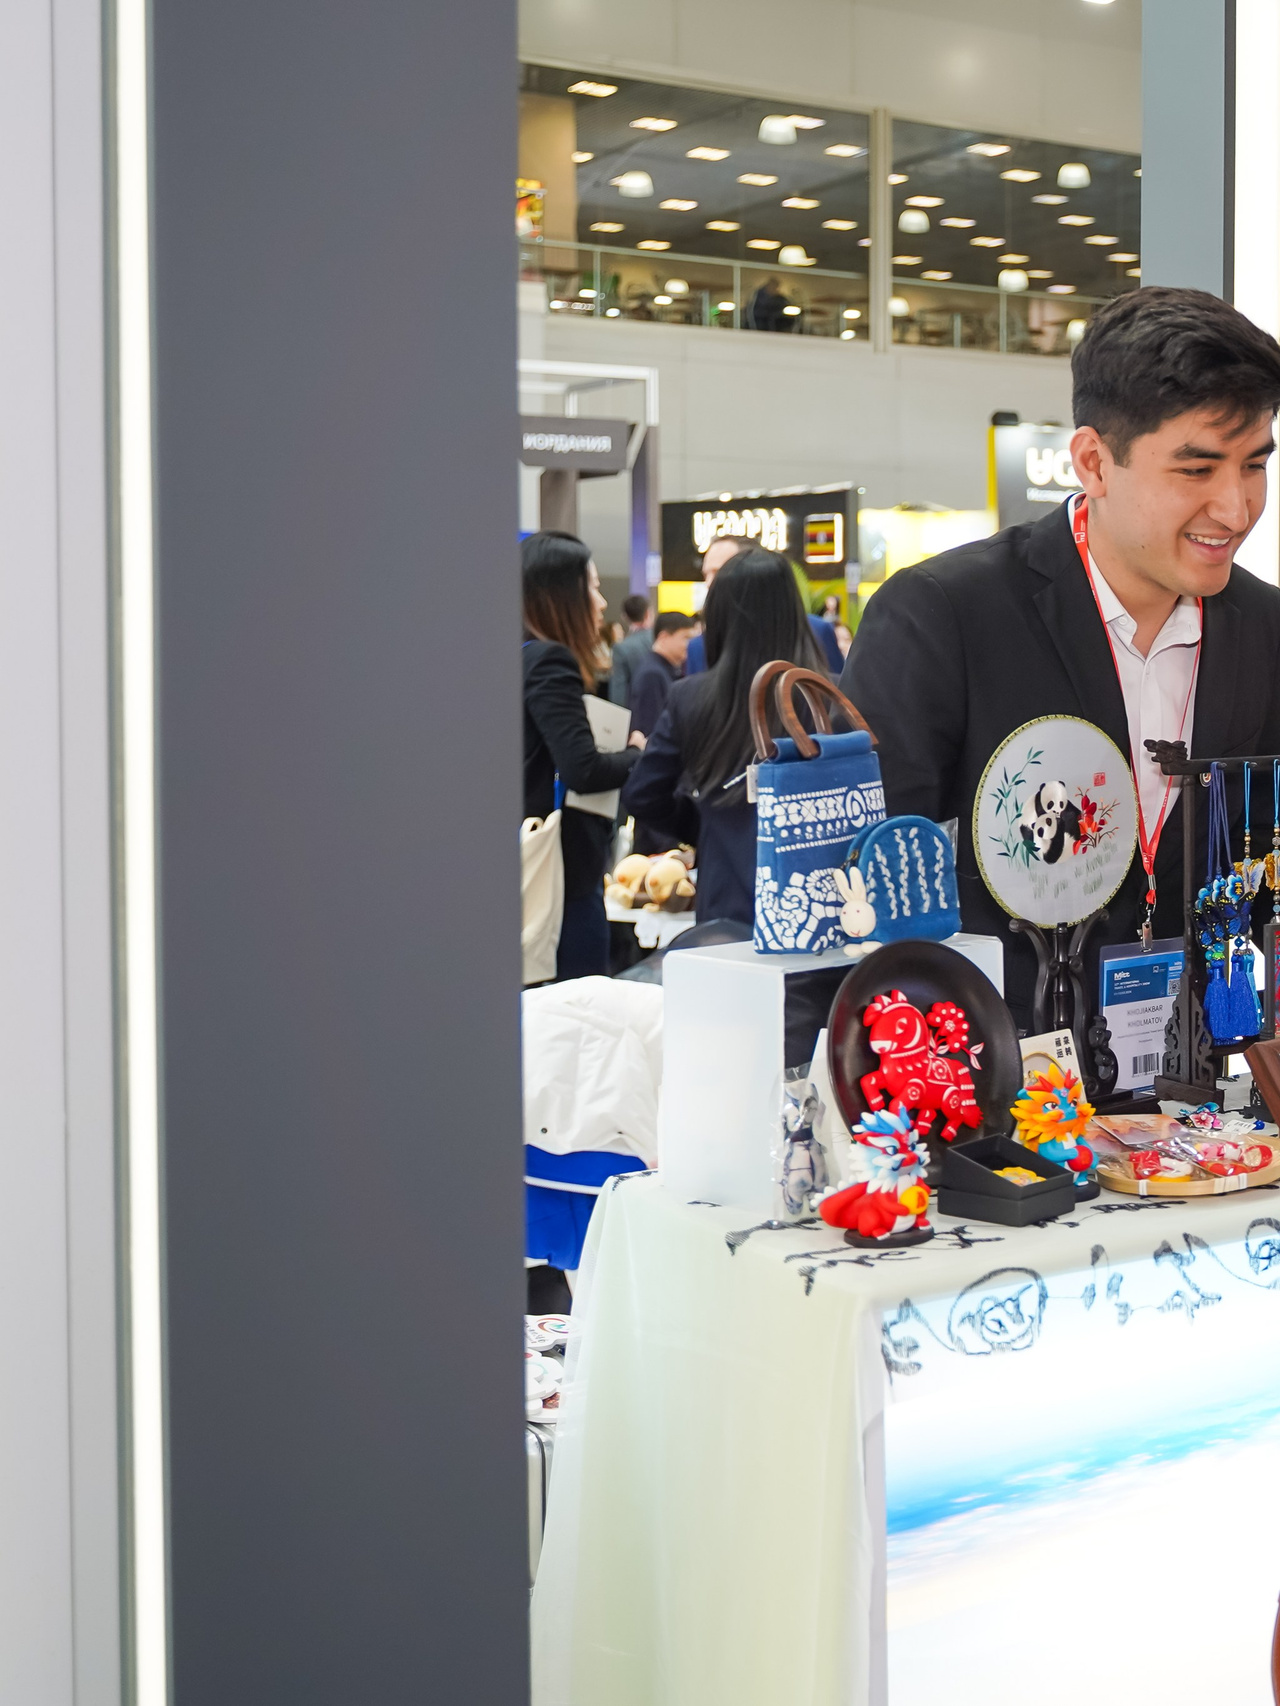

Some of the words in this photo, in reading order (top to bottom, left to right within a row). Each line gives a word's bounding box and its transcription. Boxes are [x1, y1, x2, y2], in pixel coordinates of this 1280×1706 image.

[523, 433, 611, 453] ИОРДАНИЯ
[1126, 1004, 1164, 1016] KHOJIAKBAR
[1127, 1016, 1163, 1028] KHOLMATOV
